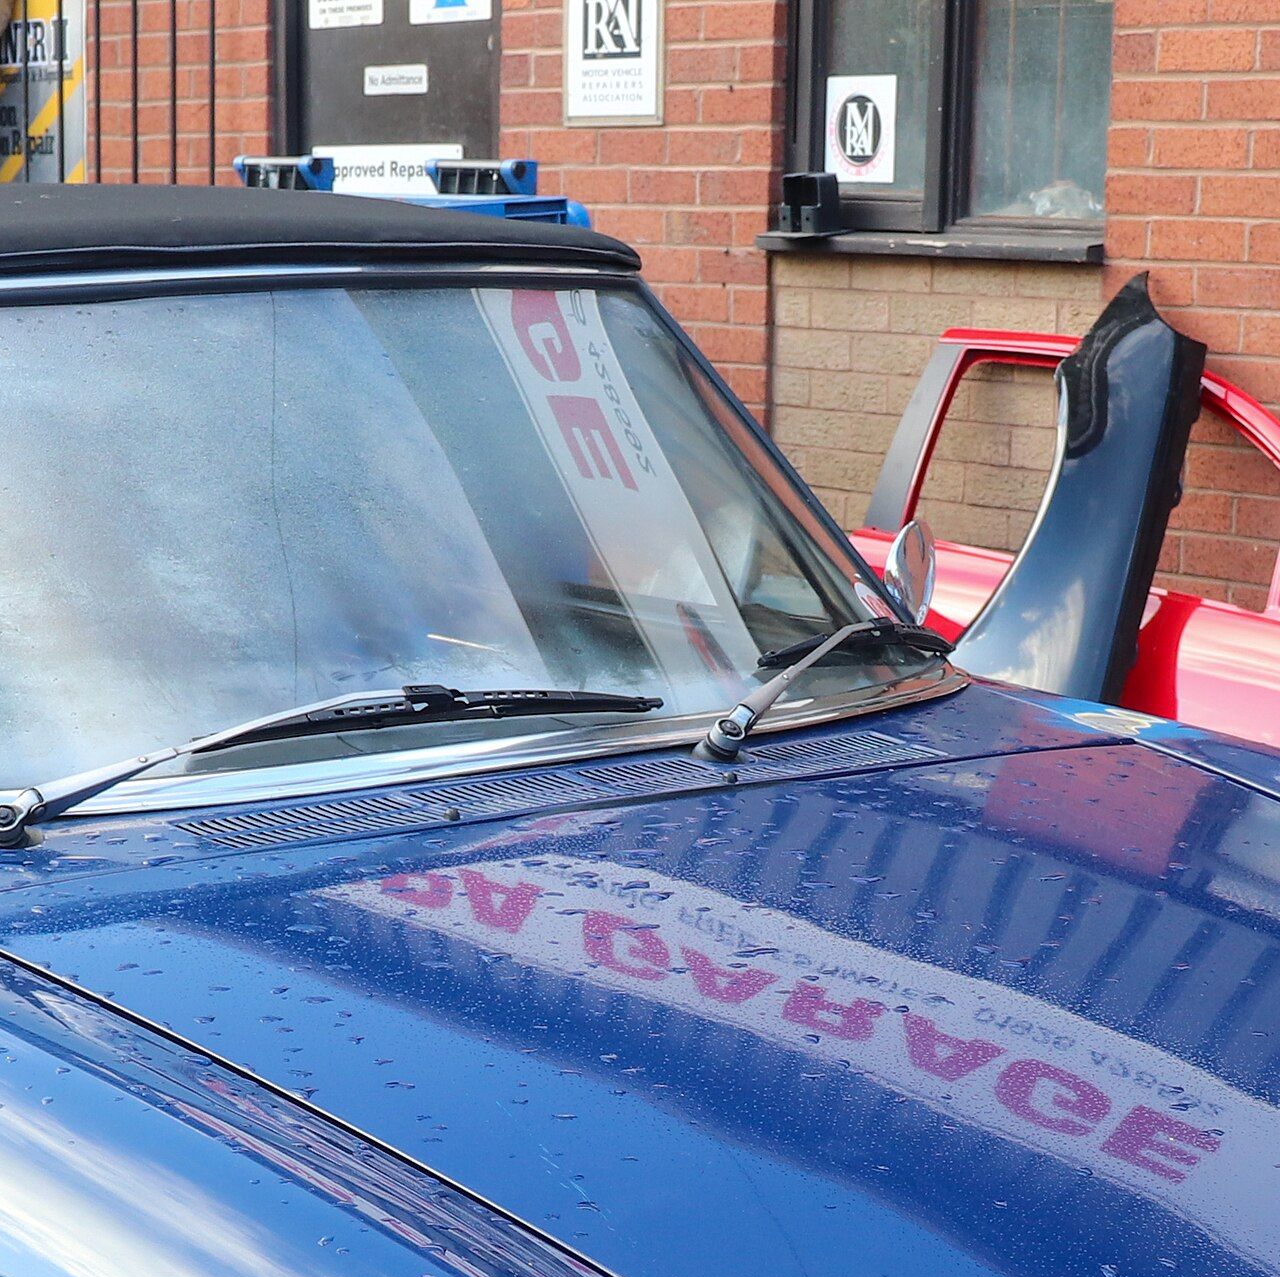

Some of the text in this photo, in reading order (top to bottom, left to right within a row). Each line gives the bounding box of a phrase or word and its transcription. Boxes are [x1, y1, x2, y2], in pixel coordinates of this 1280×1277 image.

[581, 67, 643, 77] MOTOR VEHICLE
[368, 74, 423, 87] No Admittance
[581, 80, 644, 90] REPAIRERS
[582, 93, 643, 103] ASSOCIATION
[333, 161, 385, 181] pproved
